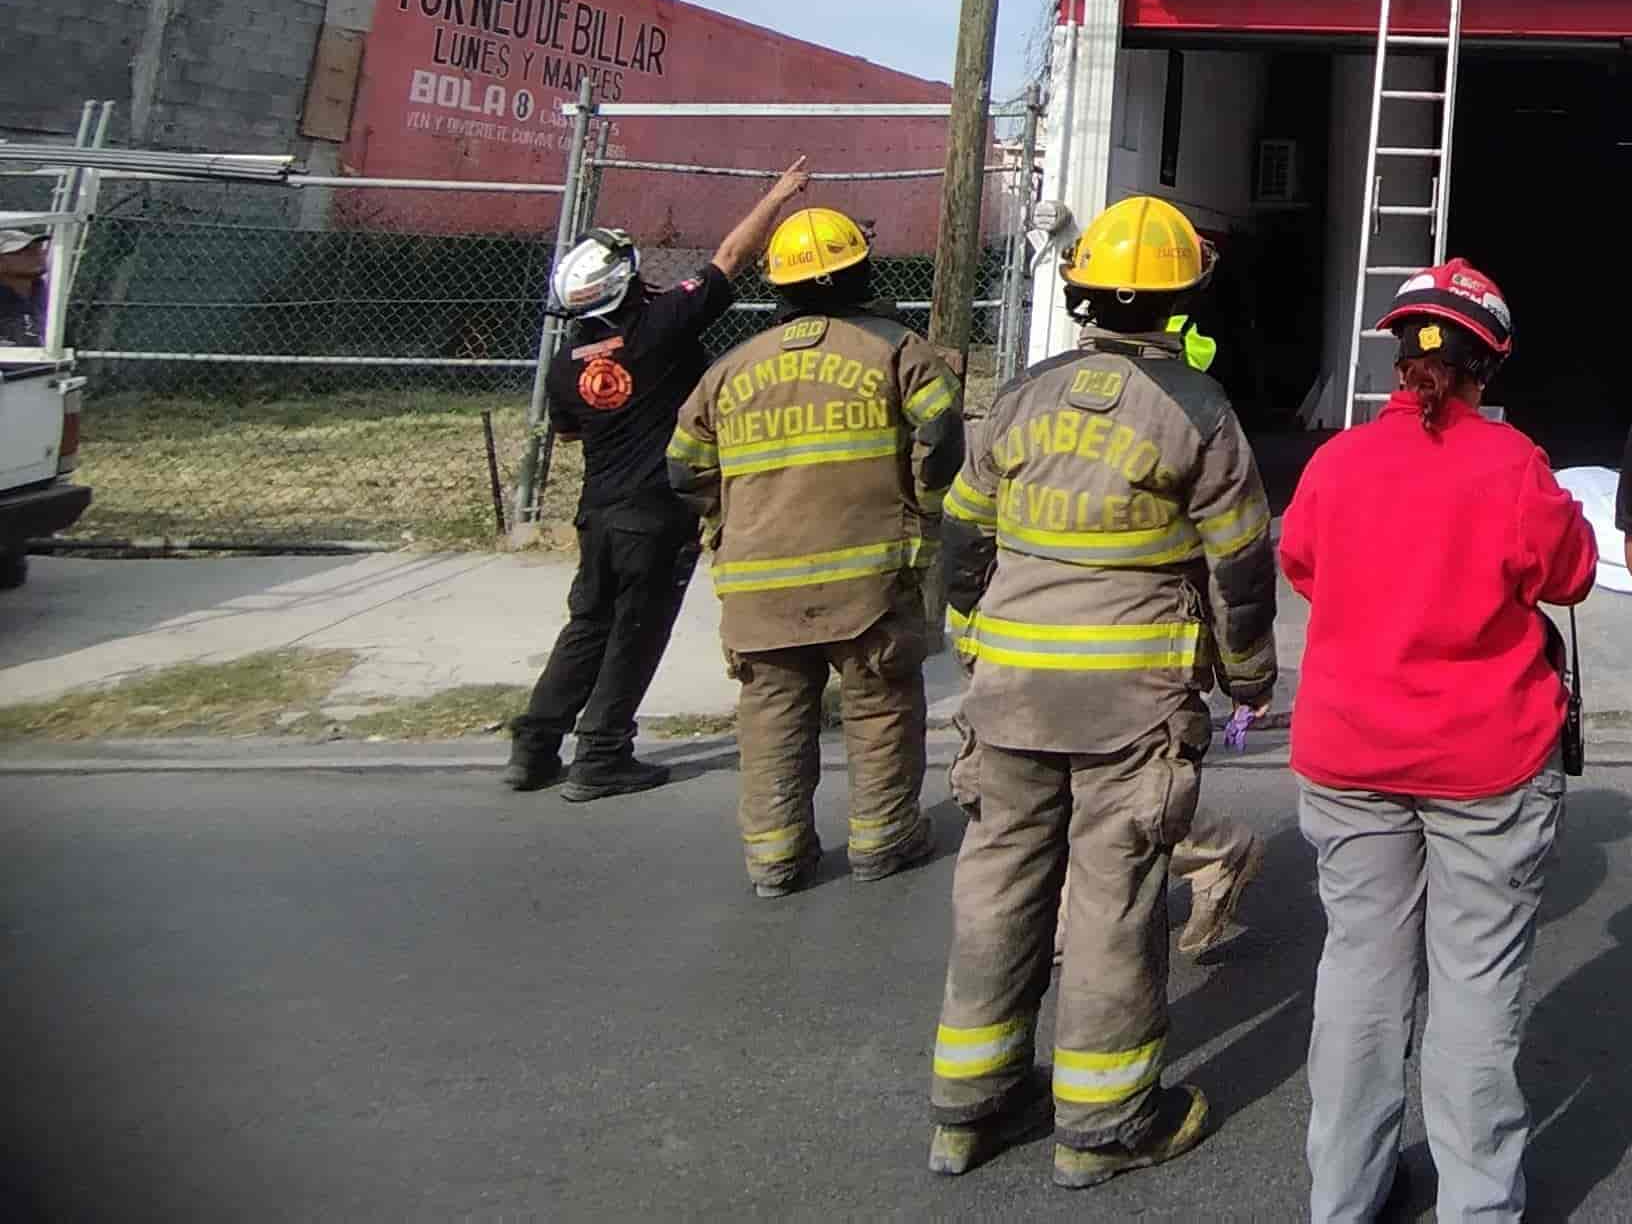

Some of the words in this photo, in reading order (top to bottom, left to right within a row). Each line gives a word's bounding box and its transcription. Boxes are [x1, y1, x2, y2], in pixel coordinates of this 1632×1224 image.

[432, 27, 511, 78] LUNES
[522, 50, 535, 81] Y
[571, 2, 667, 76] BILLAR
[409, 70, 507, 117] BOLA
[716, 350, 887, 416] BOMBEROS
